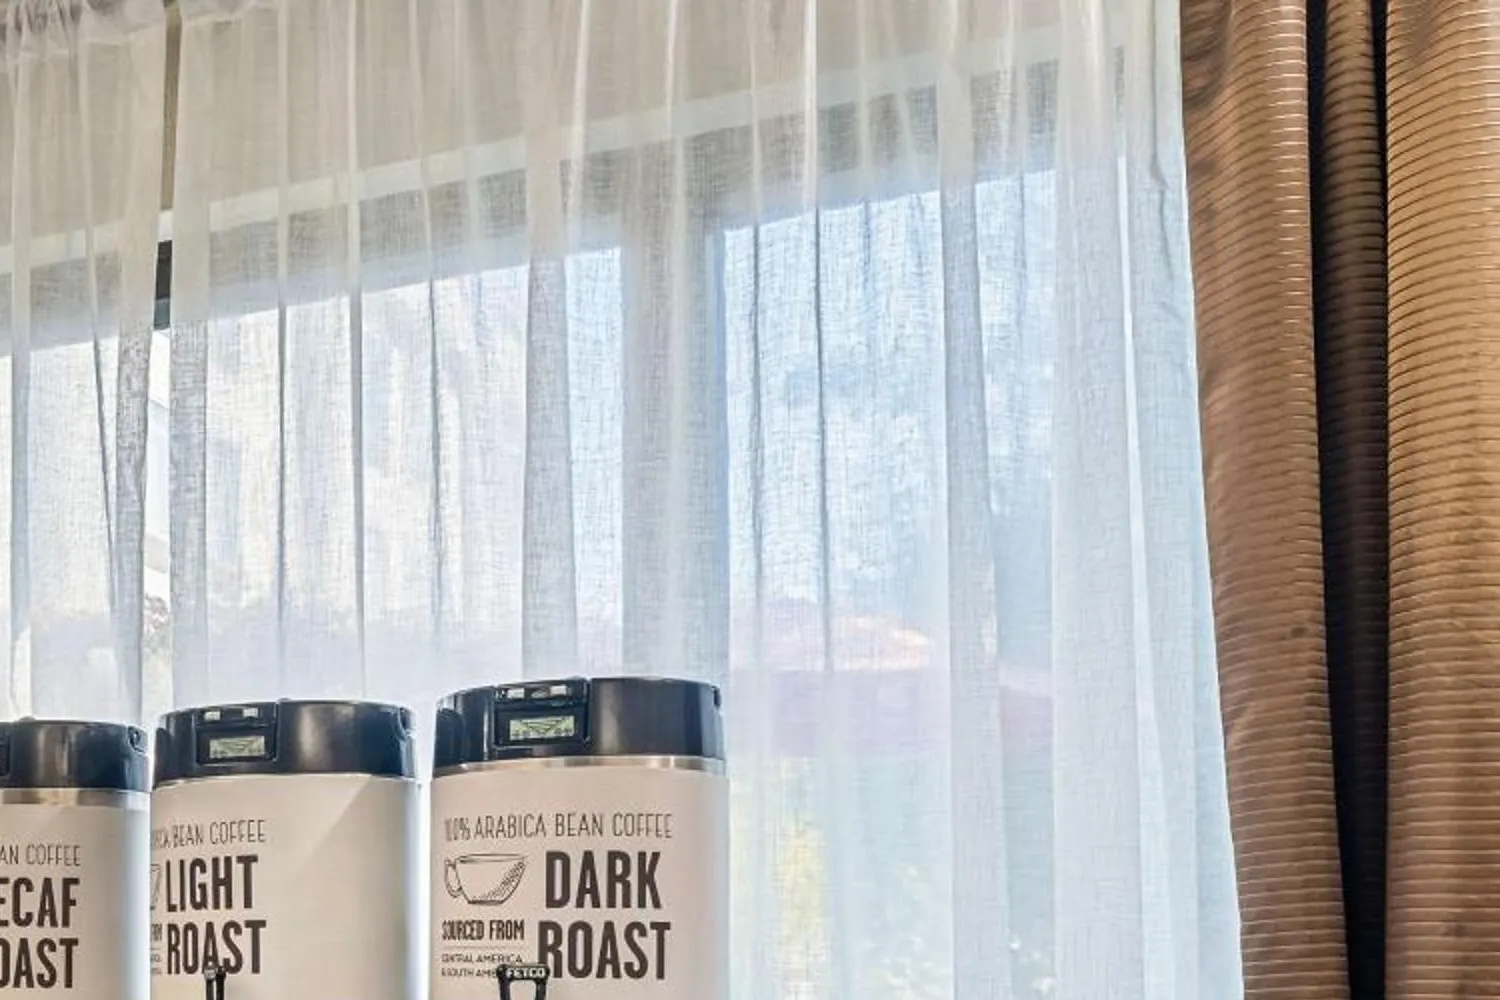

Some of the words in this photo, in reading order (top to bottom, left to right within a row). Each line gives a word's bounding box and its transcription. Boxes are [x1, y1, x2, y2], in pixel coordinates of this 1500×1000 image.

[173, 823, 205, 848] BEAN
[209, 819, 267, 845] COFFEE
[473, 813, 548, 840] ARABICA
[554, 812, 604, 838] BEAN
[612, 812, 673, 838] COFFEE
[25, 843, 82, 866] COFFEE
[166, 855, 259, 913] LIGHT
[545, 850, 662, 909] DARK
[441, 919, 485, 940] SOURCED
[489, 919, 524, 940] FROM
[167, 919, 267, 975] ROAST
[537, 920, 672, 980] ROAST
[505, 967, 546, 978] FETCO
